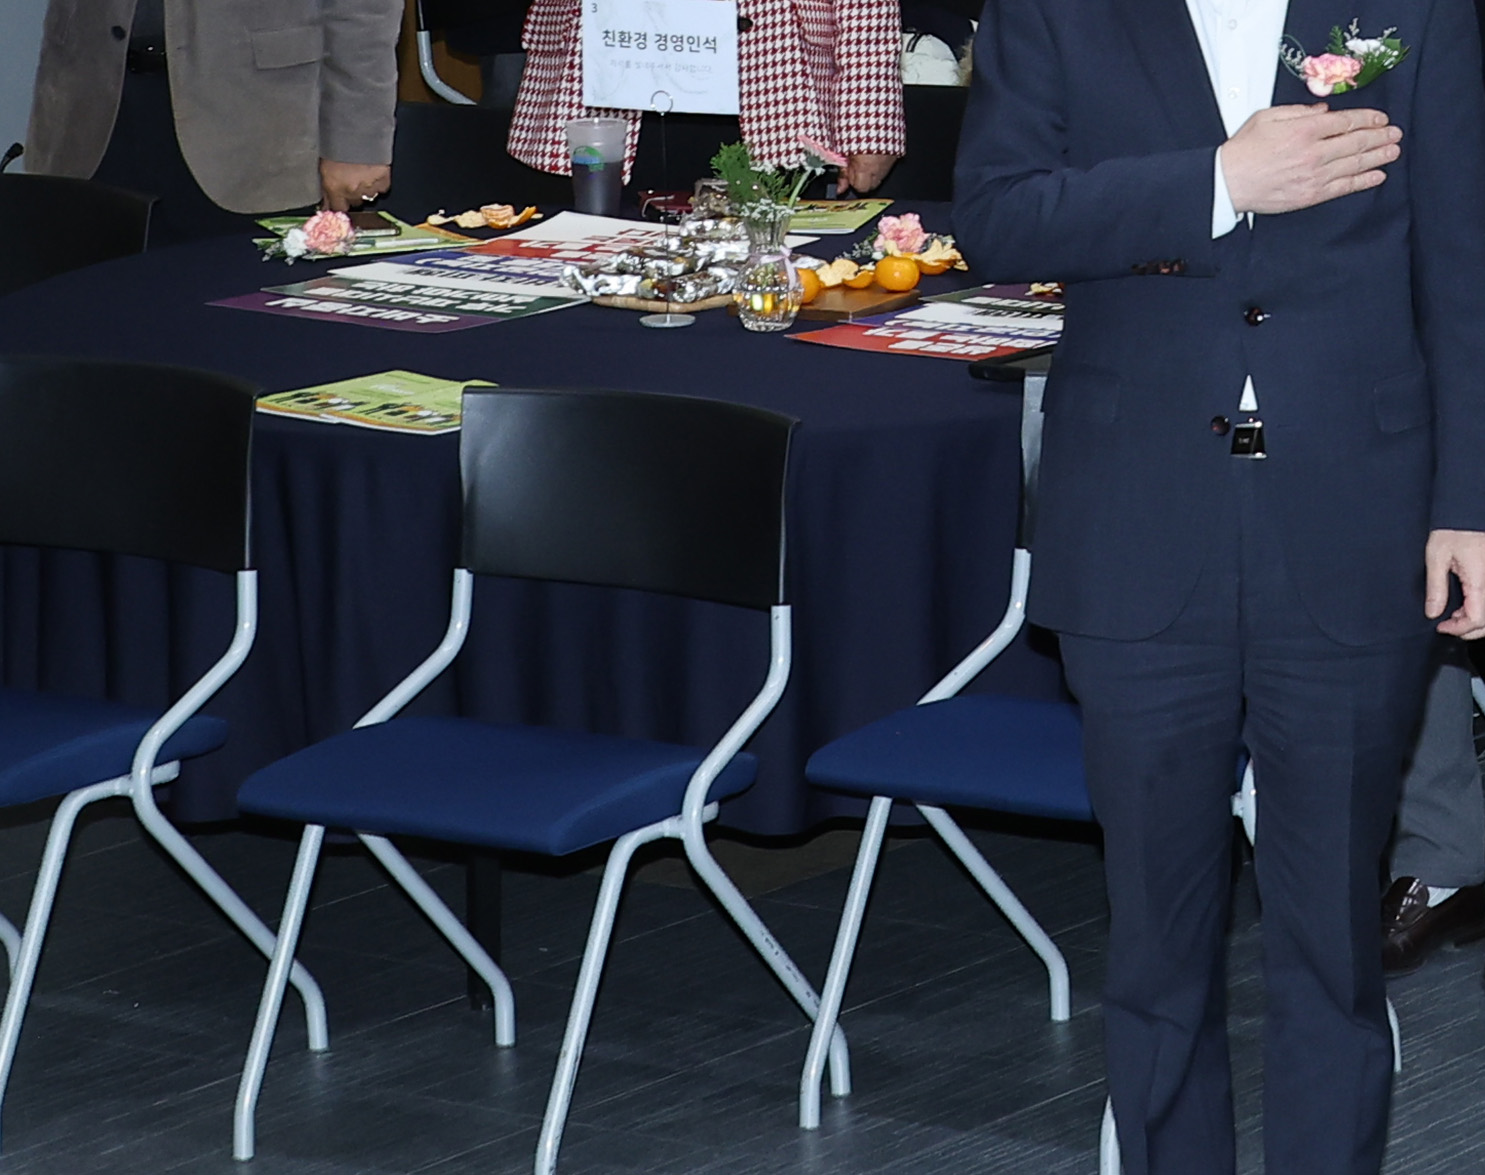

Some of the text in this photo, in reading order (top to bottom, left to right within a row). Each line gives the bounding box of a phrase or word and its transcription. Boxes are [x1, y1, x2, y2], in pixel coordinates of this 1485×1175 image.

[591, 3, 598, 13] 3
[602, 29, 717, 54] 친환경 경영인석
